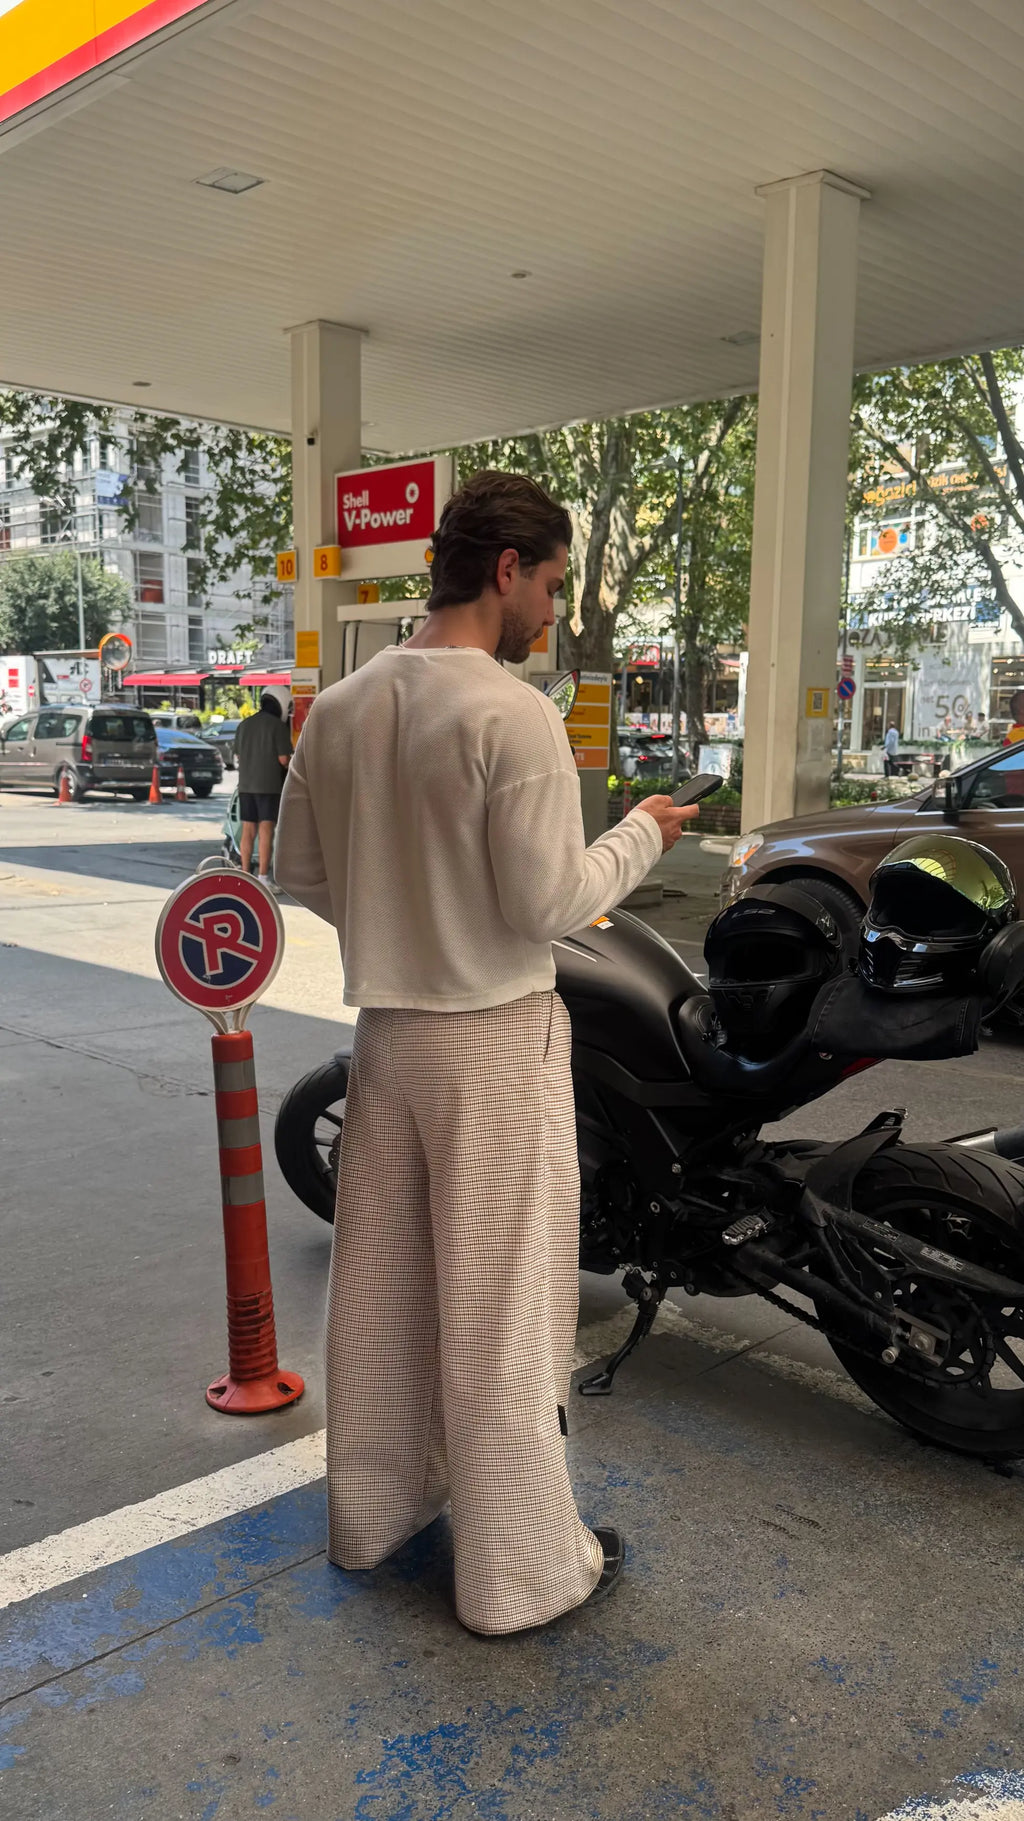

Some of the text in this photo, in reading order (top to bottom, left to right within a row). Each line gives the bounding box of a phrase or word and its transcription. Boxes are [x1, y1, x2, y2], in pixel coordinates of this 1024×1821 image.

[342, 489, 369, 509] Shell
[343, 507, 414, 532] V-Power
[280, 559, 293, 576] 10
[320, 554, 328, 571] 8
[360, 590, 369, 604] 7
[207, 649, 253, 665] DRAFT
